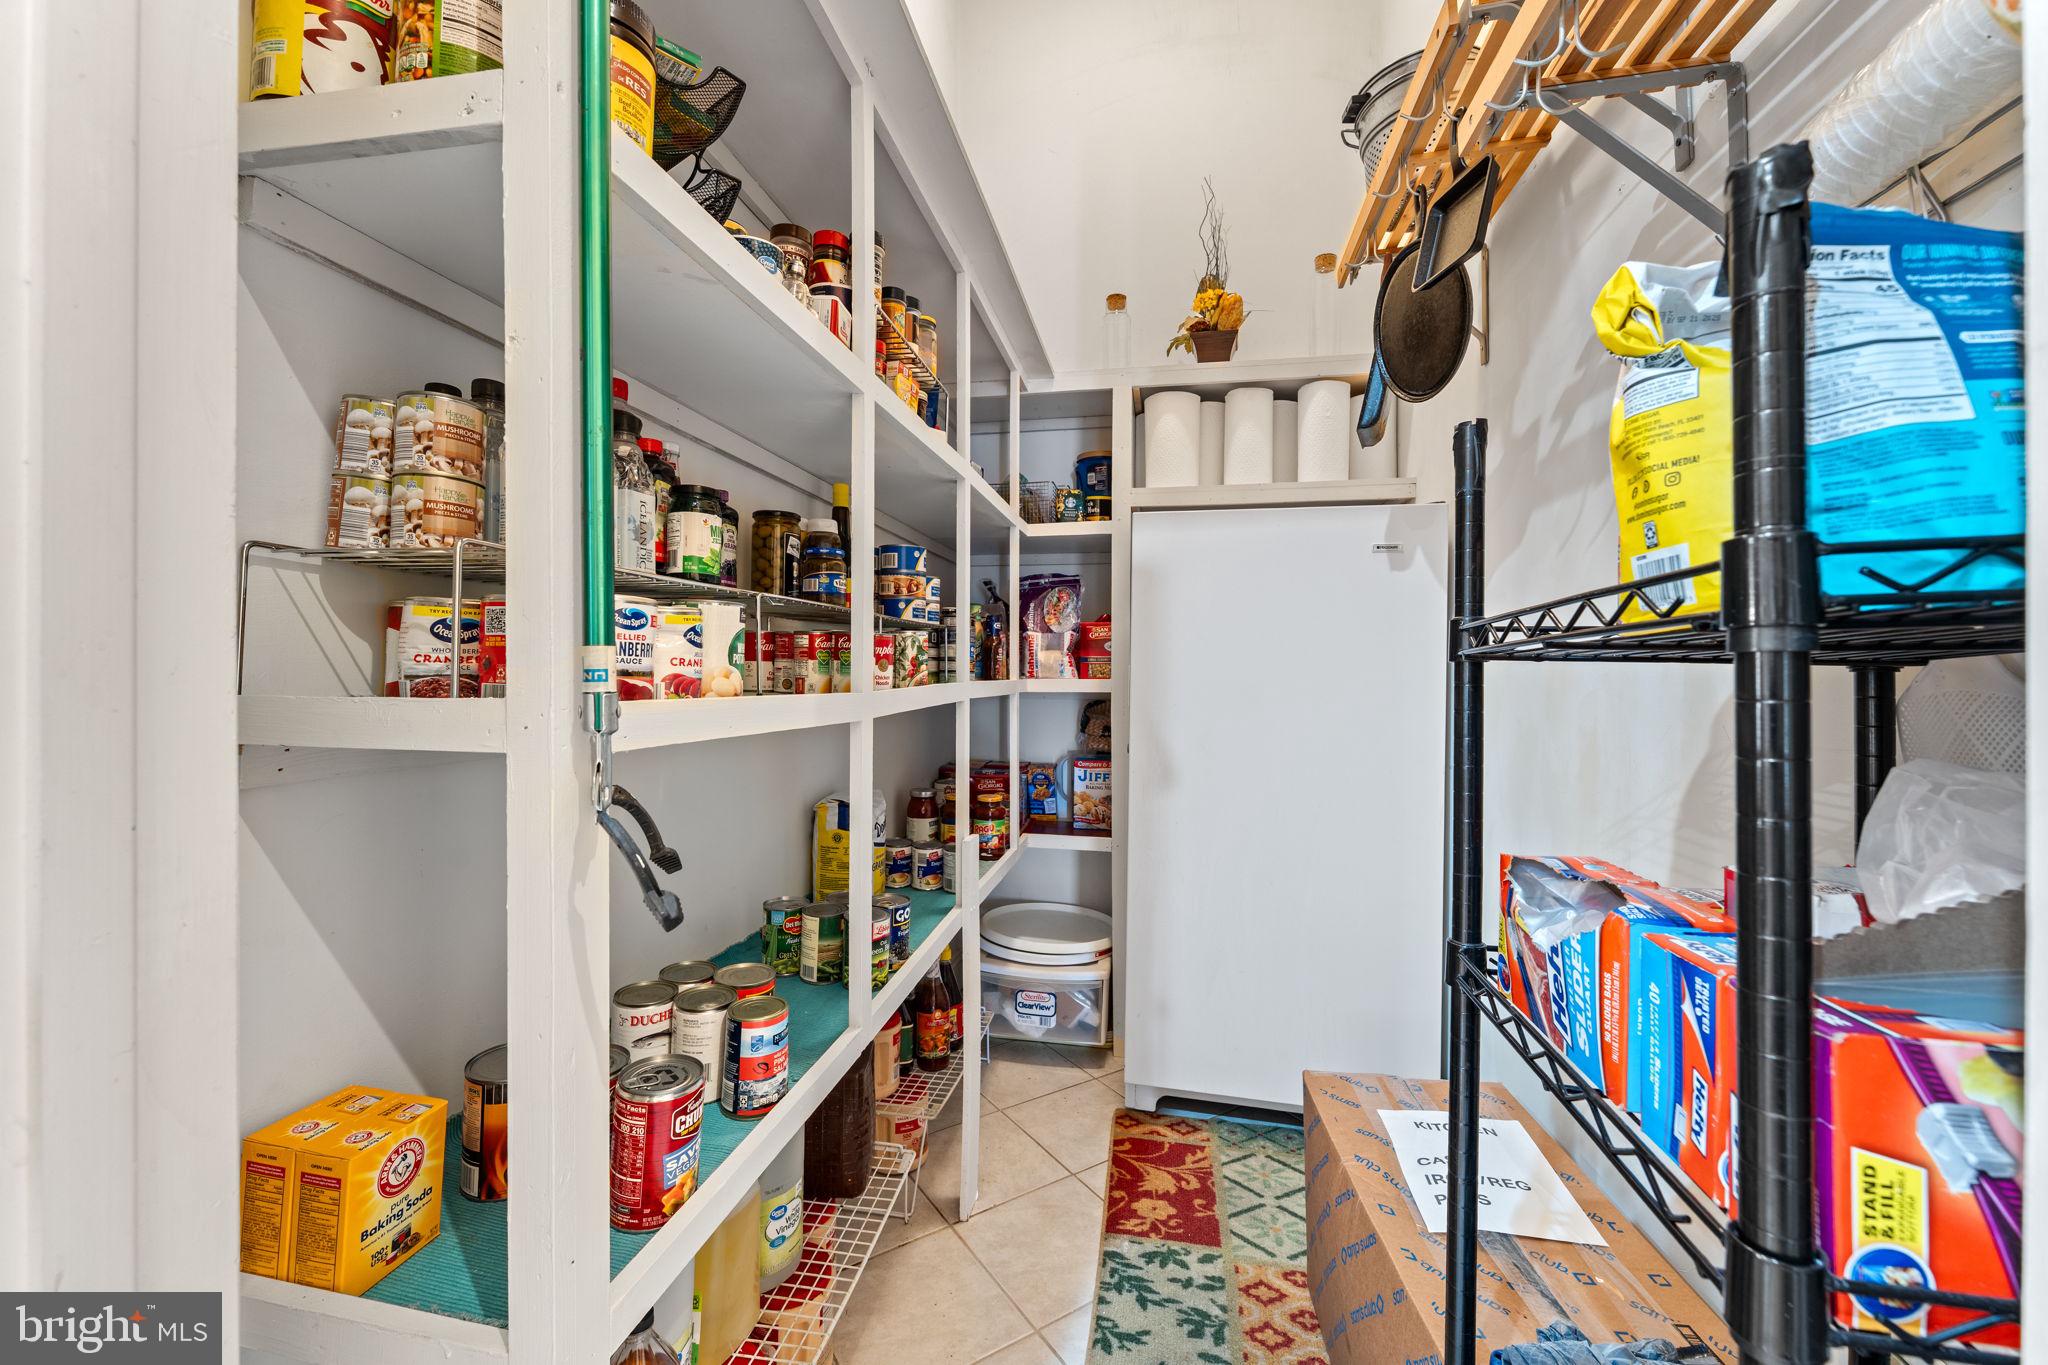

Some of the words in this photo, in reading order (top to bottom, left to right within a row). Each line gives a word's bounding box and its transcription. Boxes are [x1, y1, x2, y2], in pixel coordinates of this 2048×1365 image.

[625, 76, 647, 99] RES
[1840, 249, 1885, 261] Facts
[437, 424, 481, 442] MUSHROOMS
[1671, 455, 1701, 468] MEDIA!
[426, 501, 475, 515] MUSHROOMS
[639, 500, 647, 570] ICELANDIC
[434, 624, 452, 637] Ocea
[631, 618, 648, 628] Spray
[616, 633, 647, 642] ELLIED
[1027, 635, 1036, 679] Mahatma
[1077, 769, 1111, 782] JIFF
[896, 907, 910, 922] GO
[1548, 944, 1568, 1032] Hef
[1603, 972, 1612, 998] BAGS
[1649, 981, 1660, 1005] 40
[1017, 1001, 1051, 1011] ClearView
[1583, 962, 1593, 1033] QUART
[1701, 979, 1710, 1035] TRUSTED
[1604, 1000, 1612, 1031] SLIDER
[1604, 1031, 1612, 1044] 50
[626, 1104, 646, 1113] Facts
[1692, 1077, 1708, 1149] Hefty
[620, 1123, 630, 1133] 100
[632, 1126, 645, 1135] 210
[380, 1158, 391, 1185] ARM
[398, 1141, 423, 1162] HAMMER
[390, 1192, 410, 1213] pure
[1863, 1164, 1877, 1237] STAND
[1881, 1179, 1894, 1220] FILL
[360, 1207, 404, 1243] Baking
[406, 1185, 433, 1209] Soda
[1881, 1226, 1894, 1239] &
[370, 1246, 389, 1262] 100+
[370, 1252, 389, 1268] USES
[1529, 1250, 1569, 1275] club
